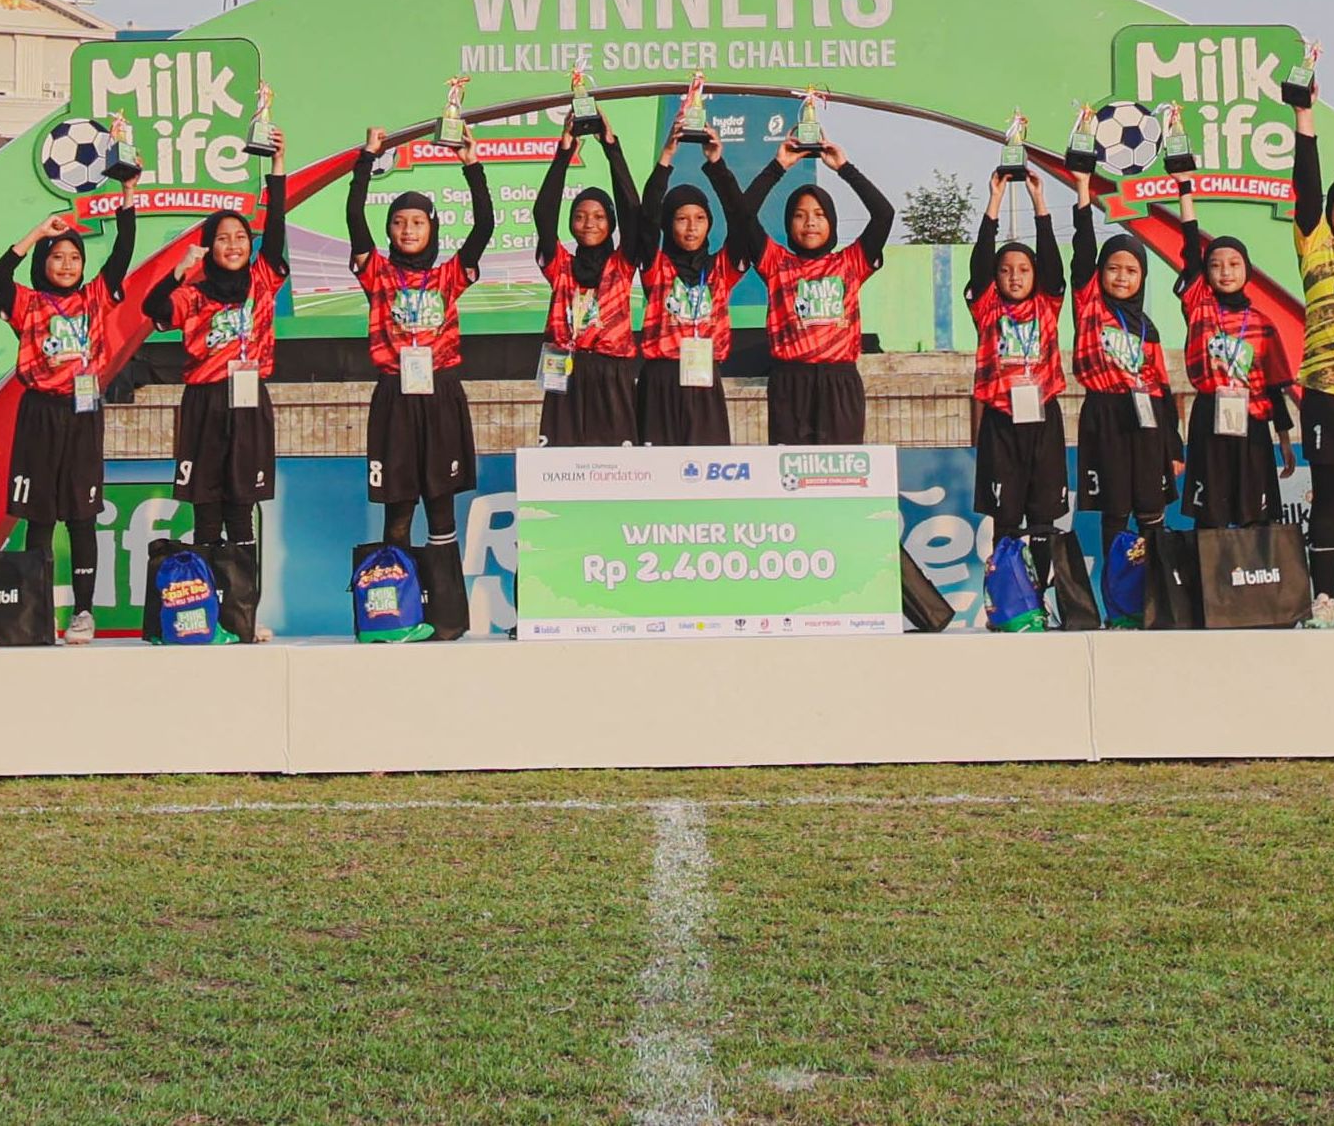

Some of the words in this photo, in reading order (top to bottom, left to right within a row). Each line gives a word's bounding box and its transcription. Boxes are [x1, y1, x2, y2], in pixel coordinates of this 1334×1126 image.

[462, 42, 593, 72] MILKLIFE
[603, 41, 717, 70] SOCCER
[728, 39, 896, 68] CHALLENGE
[1136, 37, 1286, 106] Milk
[92, 51, 244, 120] Milk
[1193, 104, 1295, 171] ife
[413, 143, 457, 159] SOCC
[1135, 178, 1197, 198] SOCCR
[1200, 177, 1291, 197] CHALLENGE
[89, 193, 150, 215] SOCER
[154, 192, 245, 211] CHALLENGE
[512, 208, 532, 224] 12
[1313, 424, 1322, 450] 1
[176, 460, 193, 486] 9
[369, 460, 382, 487] 8
[589, 469, 652, 482] foundation
[705, 462, 751, 481] BCA
[783, 453, 868, 475] MilkLife
[13, 475, 31, 504] 11
[1088, 470, 1100, 496] 3
[1193, 481, 1204, 507] 2
[1276, 502, 1311, 525] ilk
[622, 523, 726, 545] WINNER
[733, 522, 797, 549] KU10
[583, 554, 627, 589] Rp
[636, 549, 836, 581] 2.400.000
[1245, 568, 1281, 585] blibli
